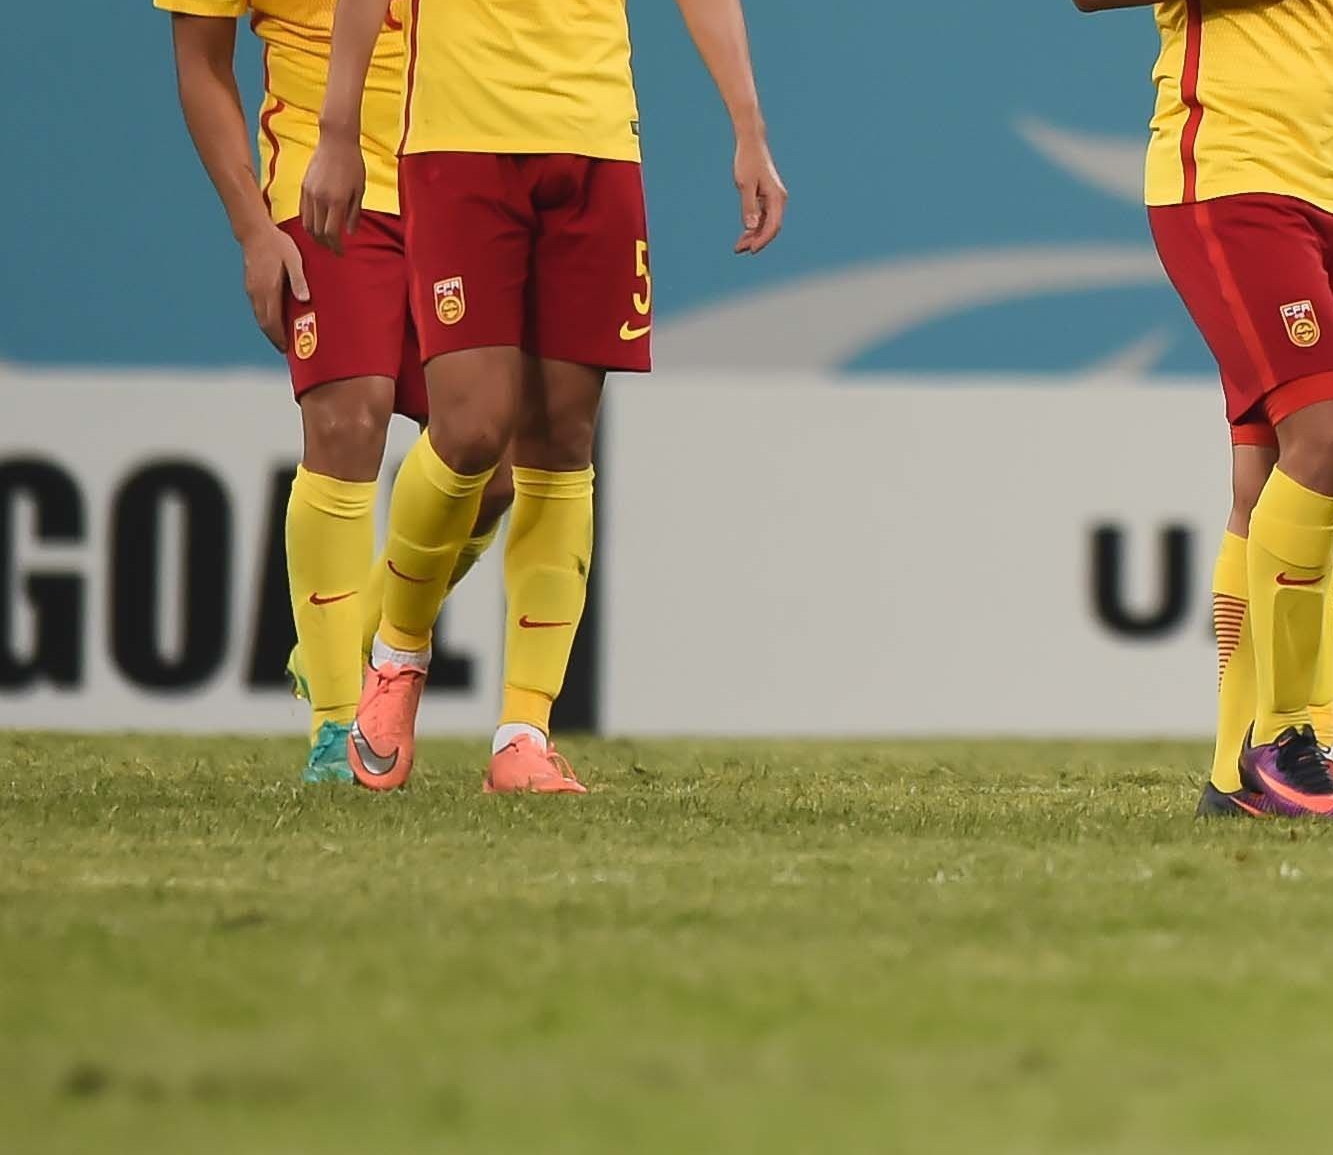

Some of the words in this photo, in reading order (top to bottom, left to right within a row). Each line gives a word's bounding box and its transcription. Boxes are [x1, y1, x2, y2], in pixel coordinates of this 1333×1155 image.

[633, 239, 652, 315] 5
[1284, 303, 1311, 317] CFA
[0, 454, 475, 696] GO
